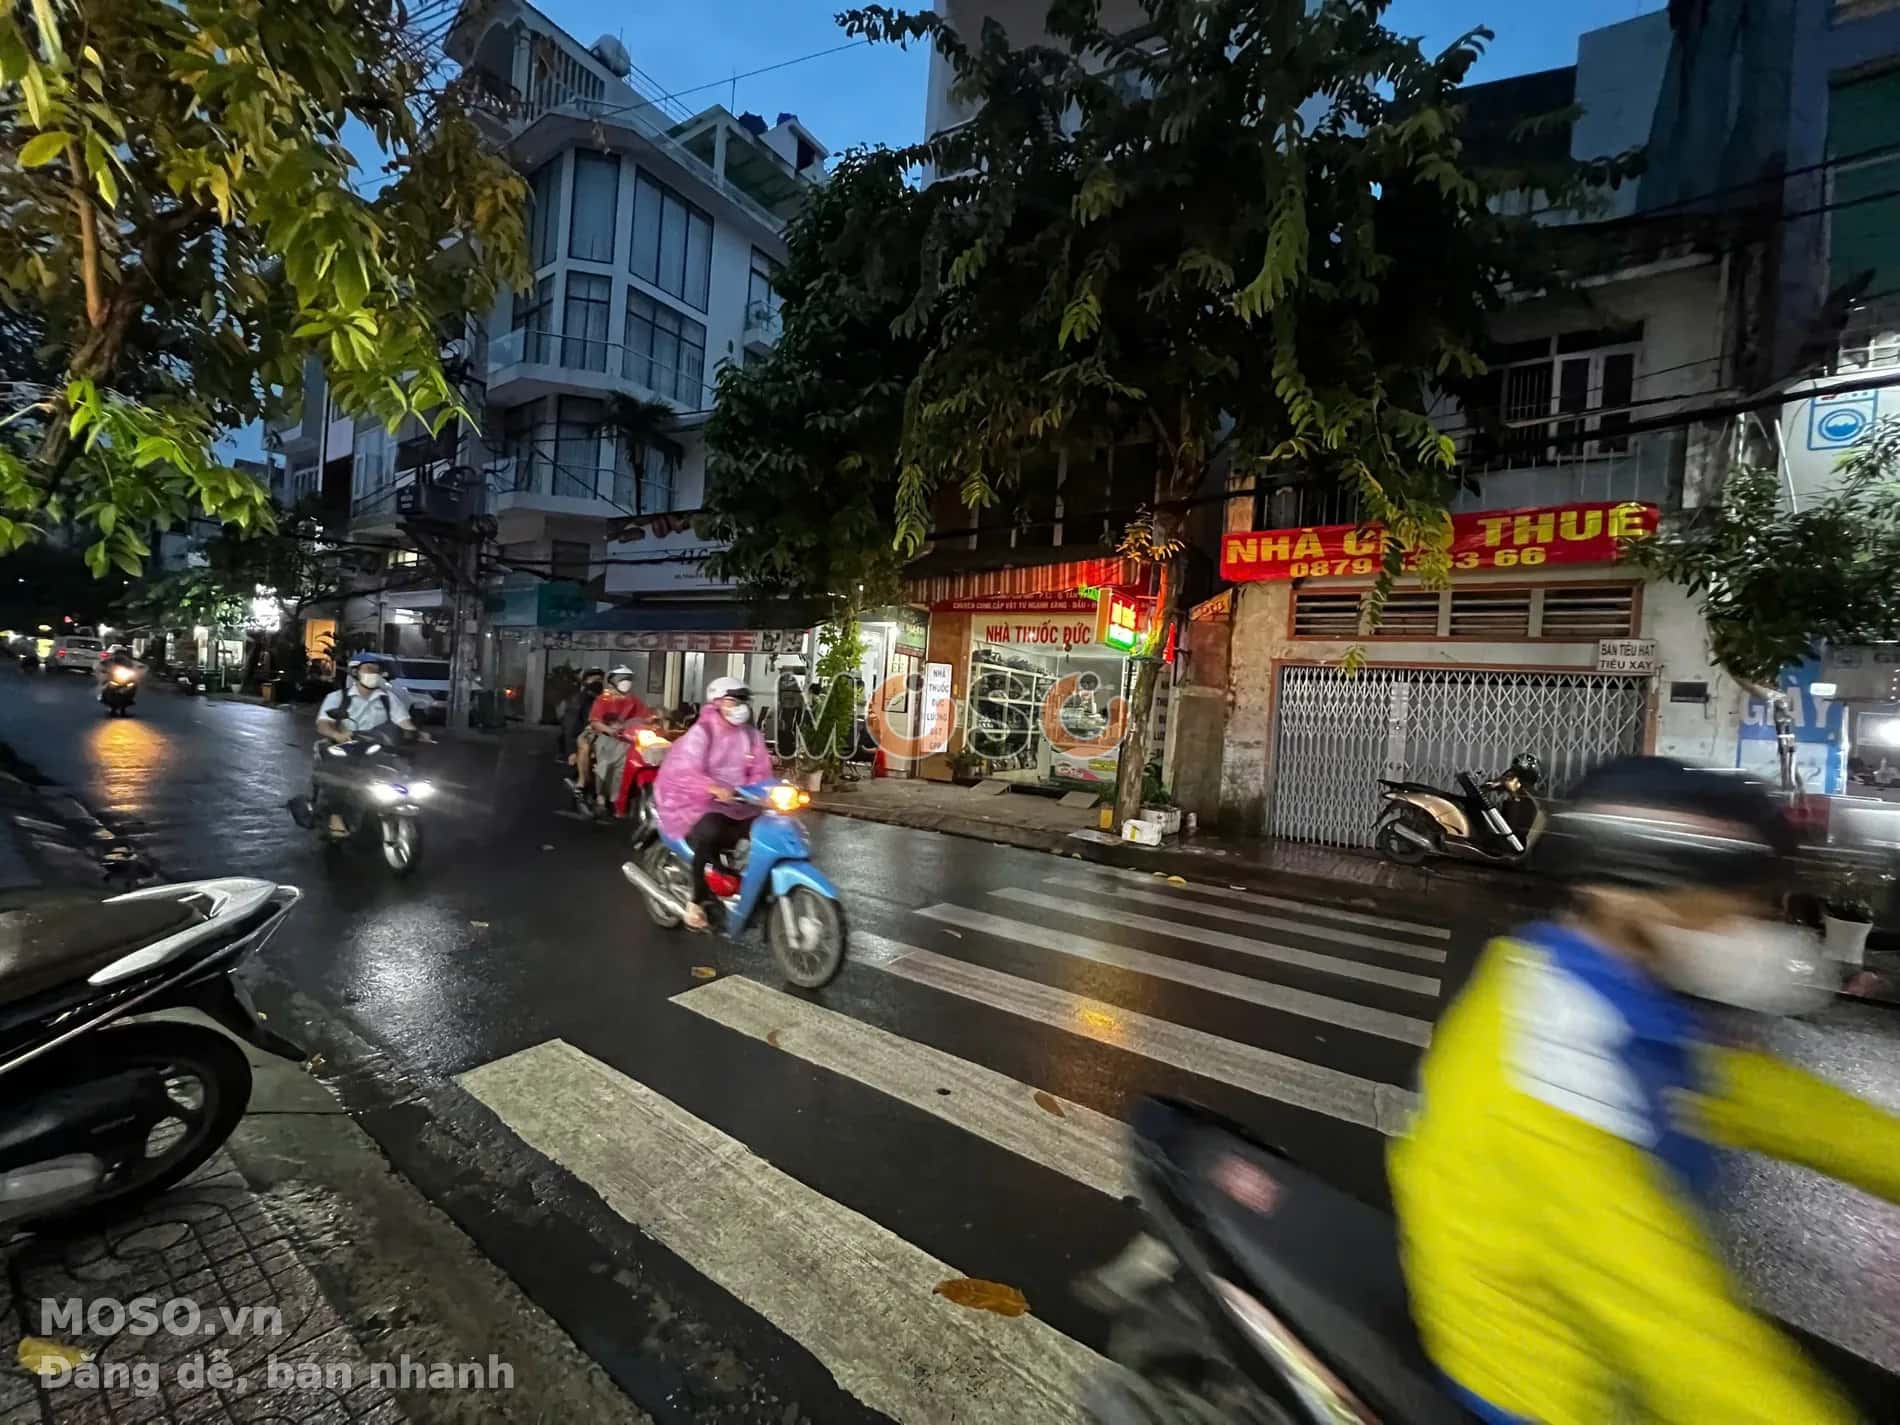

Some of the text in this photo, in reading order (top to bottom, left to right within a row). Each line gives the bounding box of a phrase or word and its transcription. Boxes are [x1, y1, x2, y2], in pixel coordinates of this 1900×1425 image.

[1226, 528, 1324, 564] NHÀ
[1478, 501, 1646, 546] THUÊ
[1290, 558, 1373, 578] 0879
[1495, 547, 1546, 567] 66
[986, 619, 1091, 645] NHÀ THUỐC ĐỨC
[1629, 660, 1653, 669] XAY
